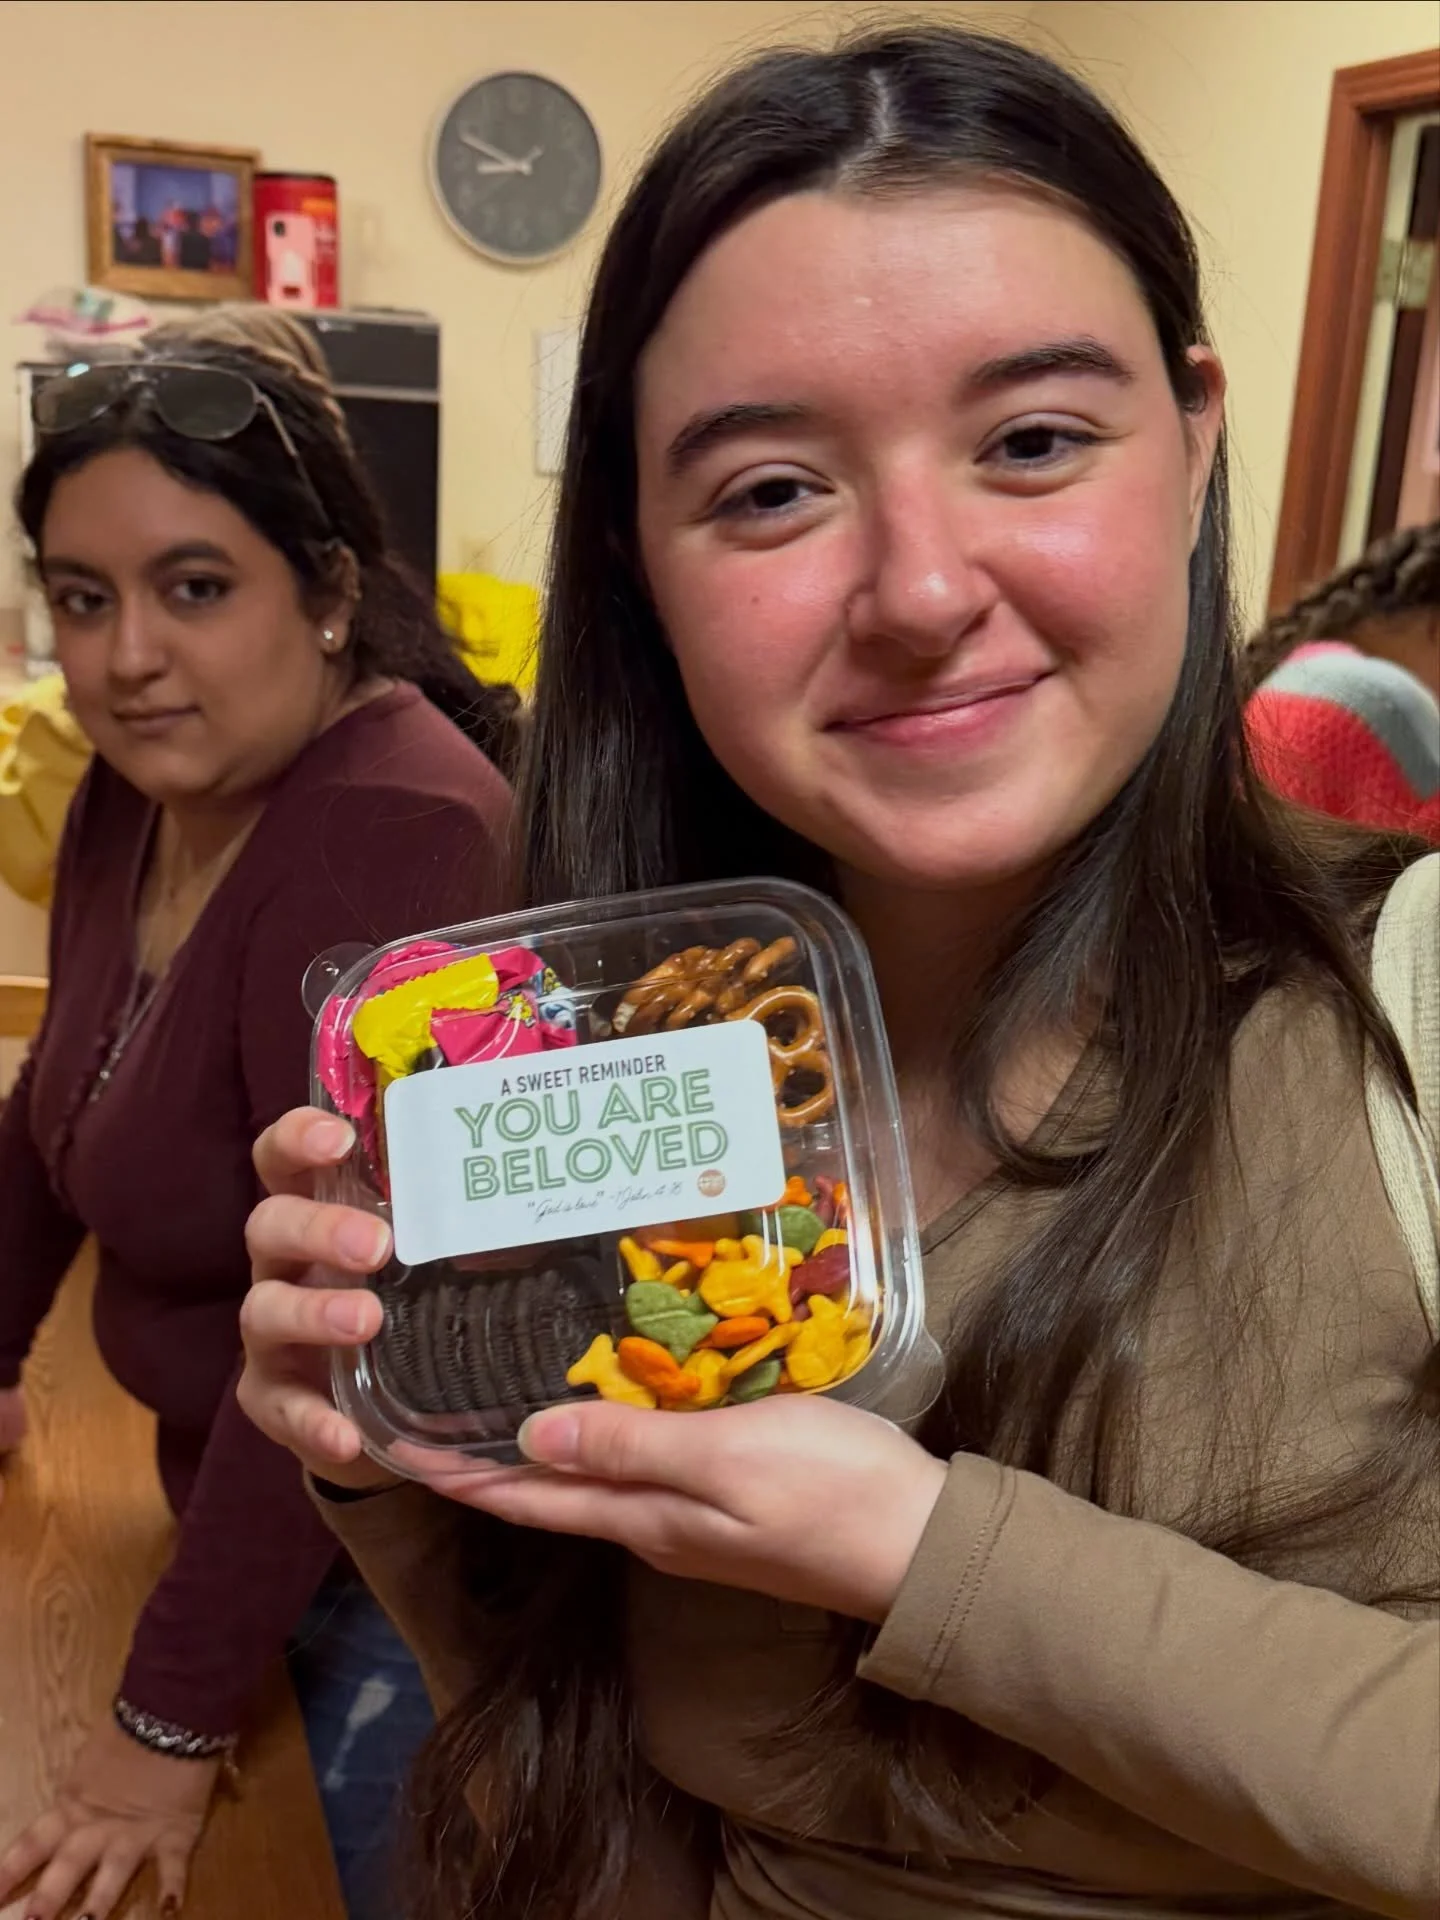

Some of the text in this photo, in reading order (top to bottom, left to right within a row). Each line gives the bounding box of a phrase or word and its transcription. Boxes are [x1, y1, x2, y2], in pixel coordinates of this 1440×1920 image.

[454, 1068, 715, 1149] YOU ARE
[501, 1054, 667, 1096] A SWEET REMINDER
[463, 1120, 729, 1201] BELOVED
